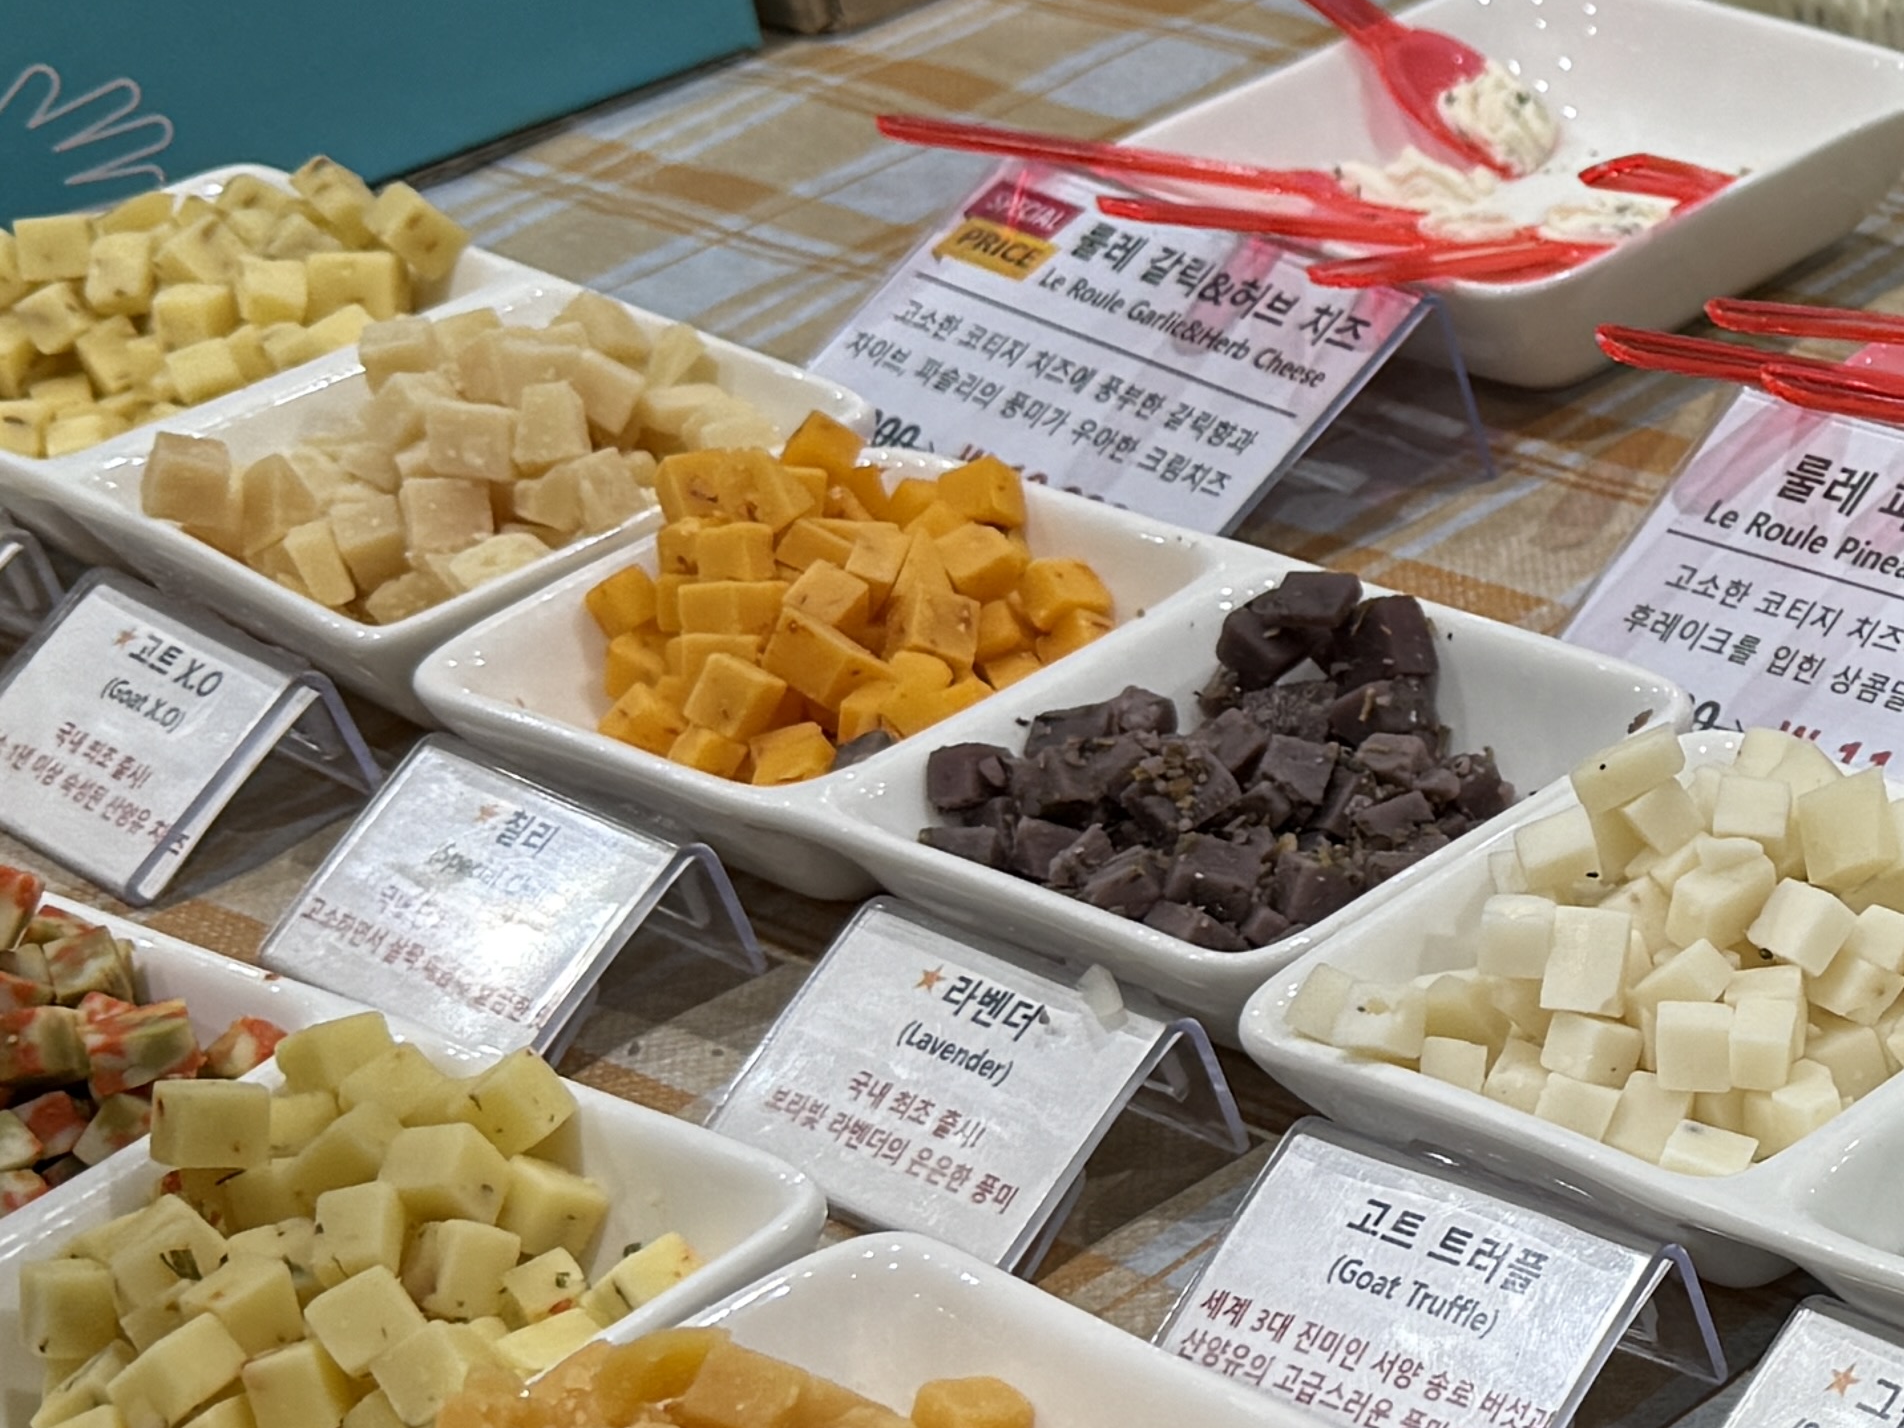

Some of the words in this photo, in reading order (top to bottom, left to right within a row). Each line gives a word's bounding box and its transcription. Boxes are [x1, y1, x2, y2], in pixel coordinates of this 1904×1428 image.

[955, 227, 1040, 268] PRICE
[1068, 222, 1149, 274] 룰레
[1138, 245, 1301, 328] 갈릭&허브
[1296, 302, 1373, 352] 치즈
[1036, 266, 1067, 292] Le
[1064, 276, 1126, 314] Roule
[1125, 298, 1251, 361] Garlic&Herb
[1251, 346, 1326, 389] Cheese
[1775, 465, 1879, 518] 룰레
[1702, 497, 1740, 530] Le
[1743, 510, 1829, 555] Roule
[126, 635, 181, 680] 고트
[172, 656, 226, 699] X.O
[97, 675, 148, 718] (Goat
[140, 697, 187, 735] X.O)
[495, 807, 560, 857] 칠리
[941, 973, 1043, 1043] 라벤더
[897, 1019, 1015, 1088] (Lavender)
[1344, 1199, 1427, 1250] 고트
[1425, 1225, 1549, 1280] 트러플
[1325, 1253, 1402, 1301] (Goat
[1404, 1278, 1500, 1339] Truffle)
